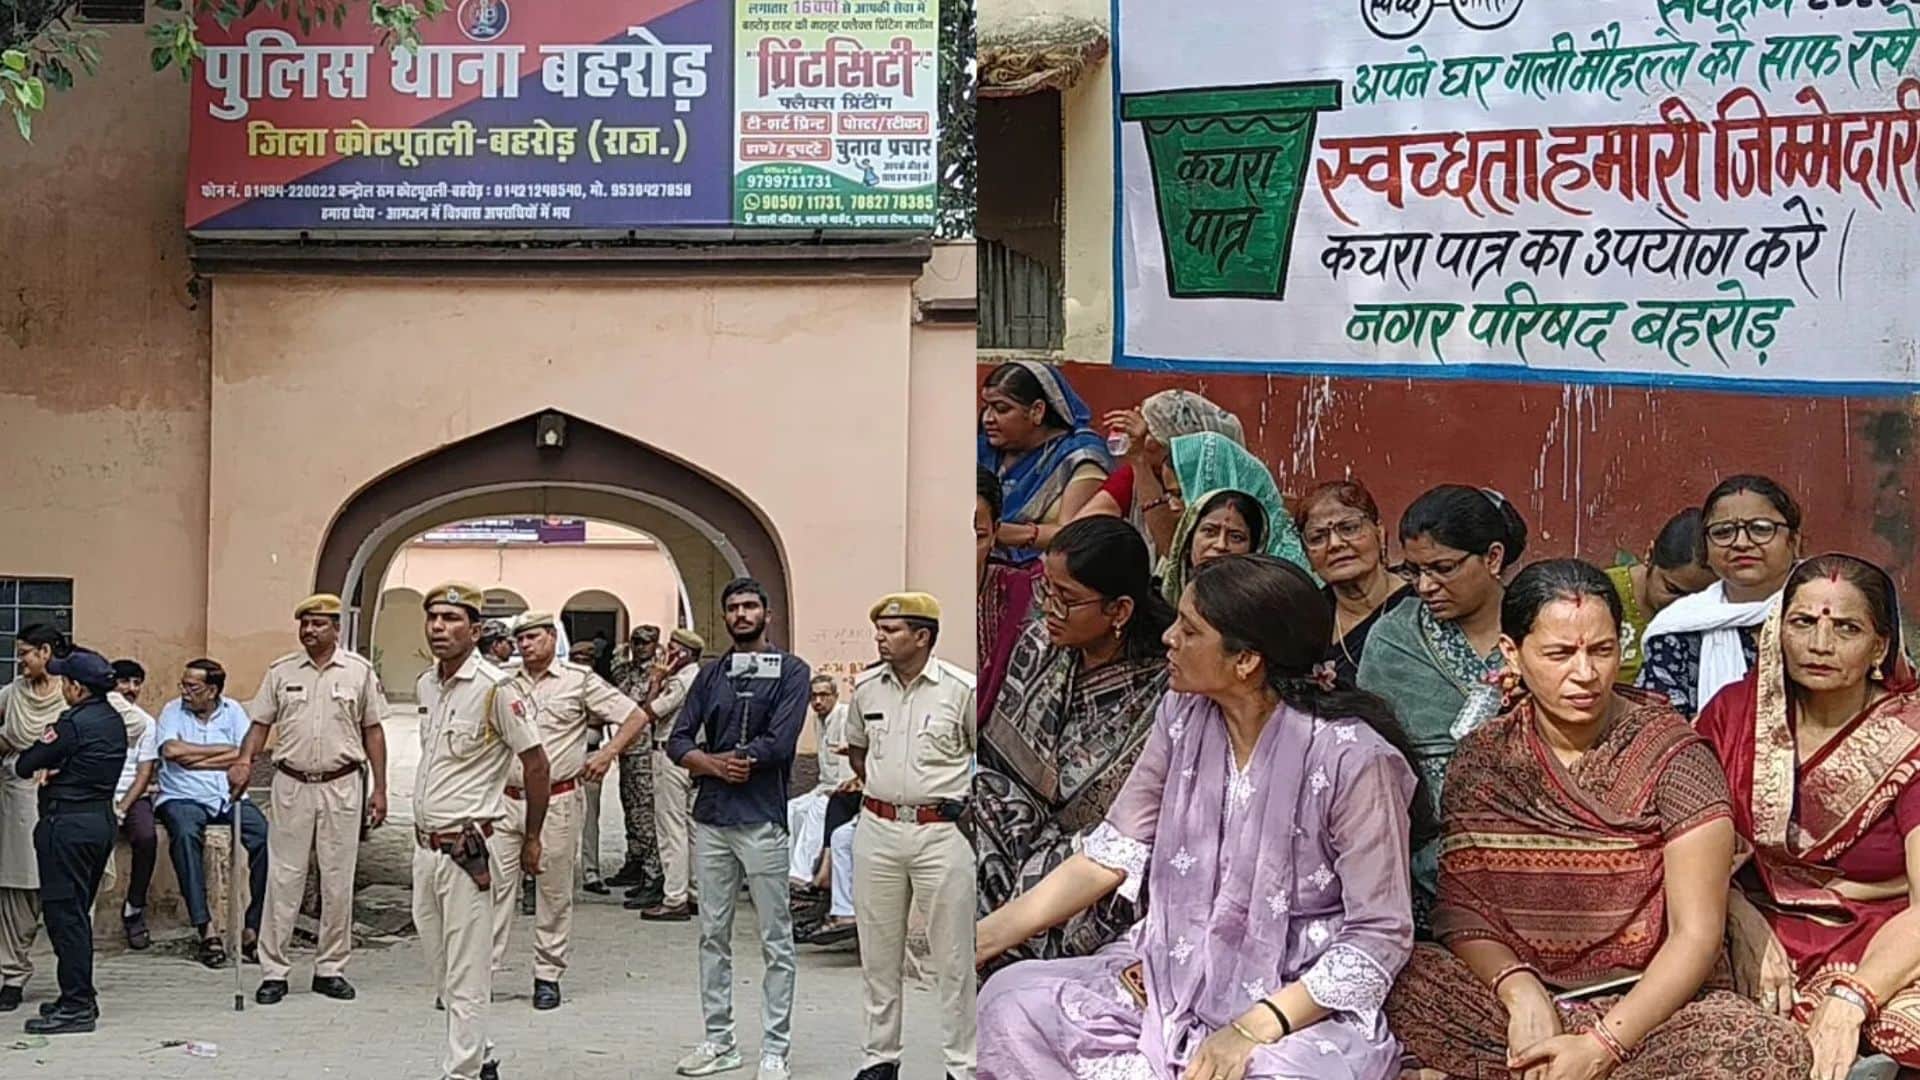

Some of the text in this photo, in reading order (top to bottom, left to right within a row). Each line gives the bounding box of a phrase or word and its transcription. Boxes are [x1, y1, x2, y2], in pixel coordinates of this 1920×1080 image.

[747, 2, 789, 15] लगातार
[206, 27, 712, 120] पुलिस थाना बहरोड़
[1352, 45, 1437, 104] अपने
[1439, 56, 1505, 110] घर
[1698, 23, 1754, 87] को
[1758, 35, 1842, 92] साफ
[248, 119, 687, 166] जिला कोटपूतली-बहरोड़ (राज.)
[836, 139, 882, 165] चुनाव
[888, 139, 932, 158] प्रचार
[1318, 129, 1543, 227] स्वच्छता
[1541, 97, 1711, 219] हमारी
[202, 183, 225, 198] फोन
[244, 183, 336, 198] 01494-220022
[746, 174, 833, 188] 9799711731
[1178, 144, 1285, 205] कचरा
[321, 206, 350, 220] हमारा
[386, 206, 428, 220] आमजन
[431, 203, 441, 220] में
[540, 203, 550, 219] में
[762, 194, 804, 210] 90507
[1185, 206, 1265, 273] पात्र
[1321, 232, 1433, 291] कचरा
[1436, 230, 1521, 291] पात्र
[1520, 229, 1584, 279] का
[1584, 204, 1749, 280] उपयोग
[1745, 195, 1828, 299] करें
[1346, 279, 1796, 369] नगर परिषद बहरोड़
